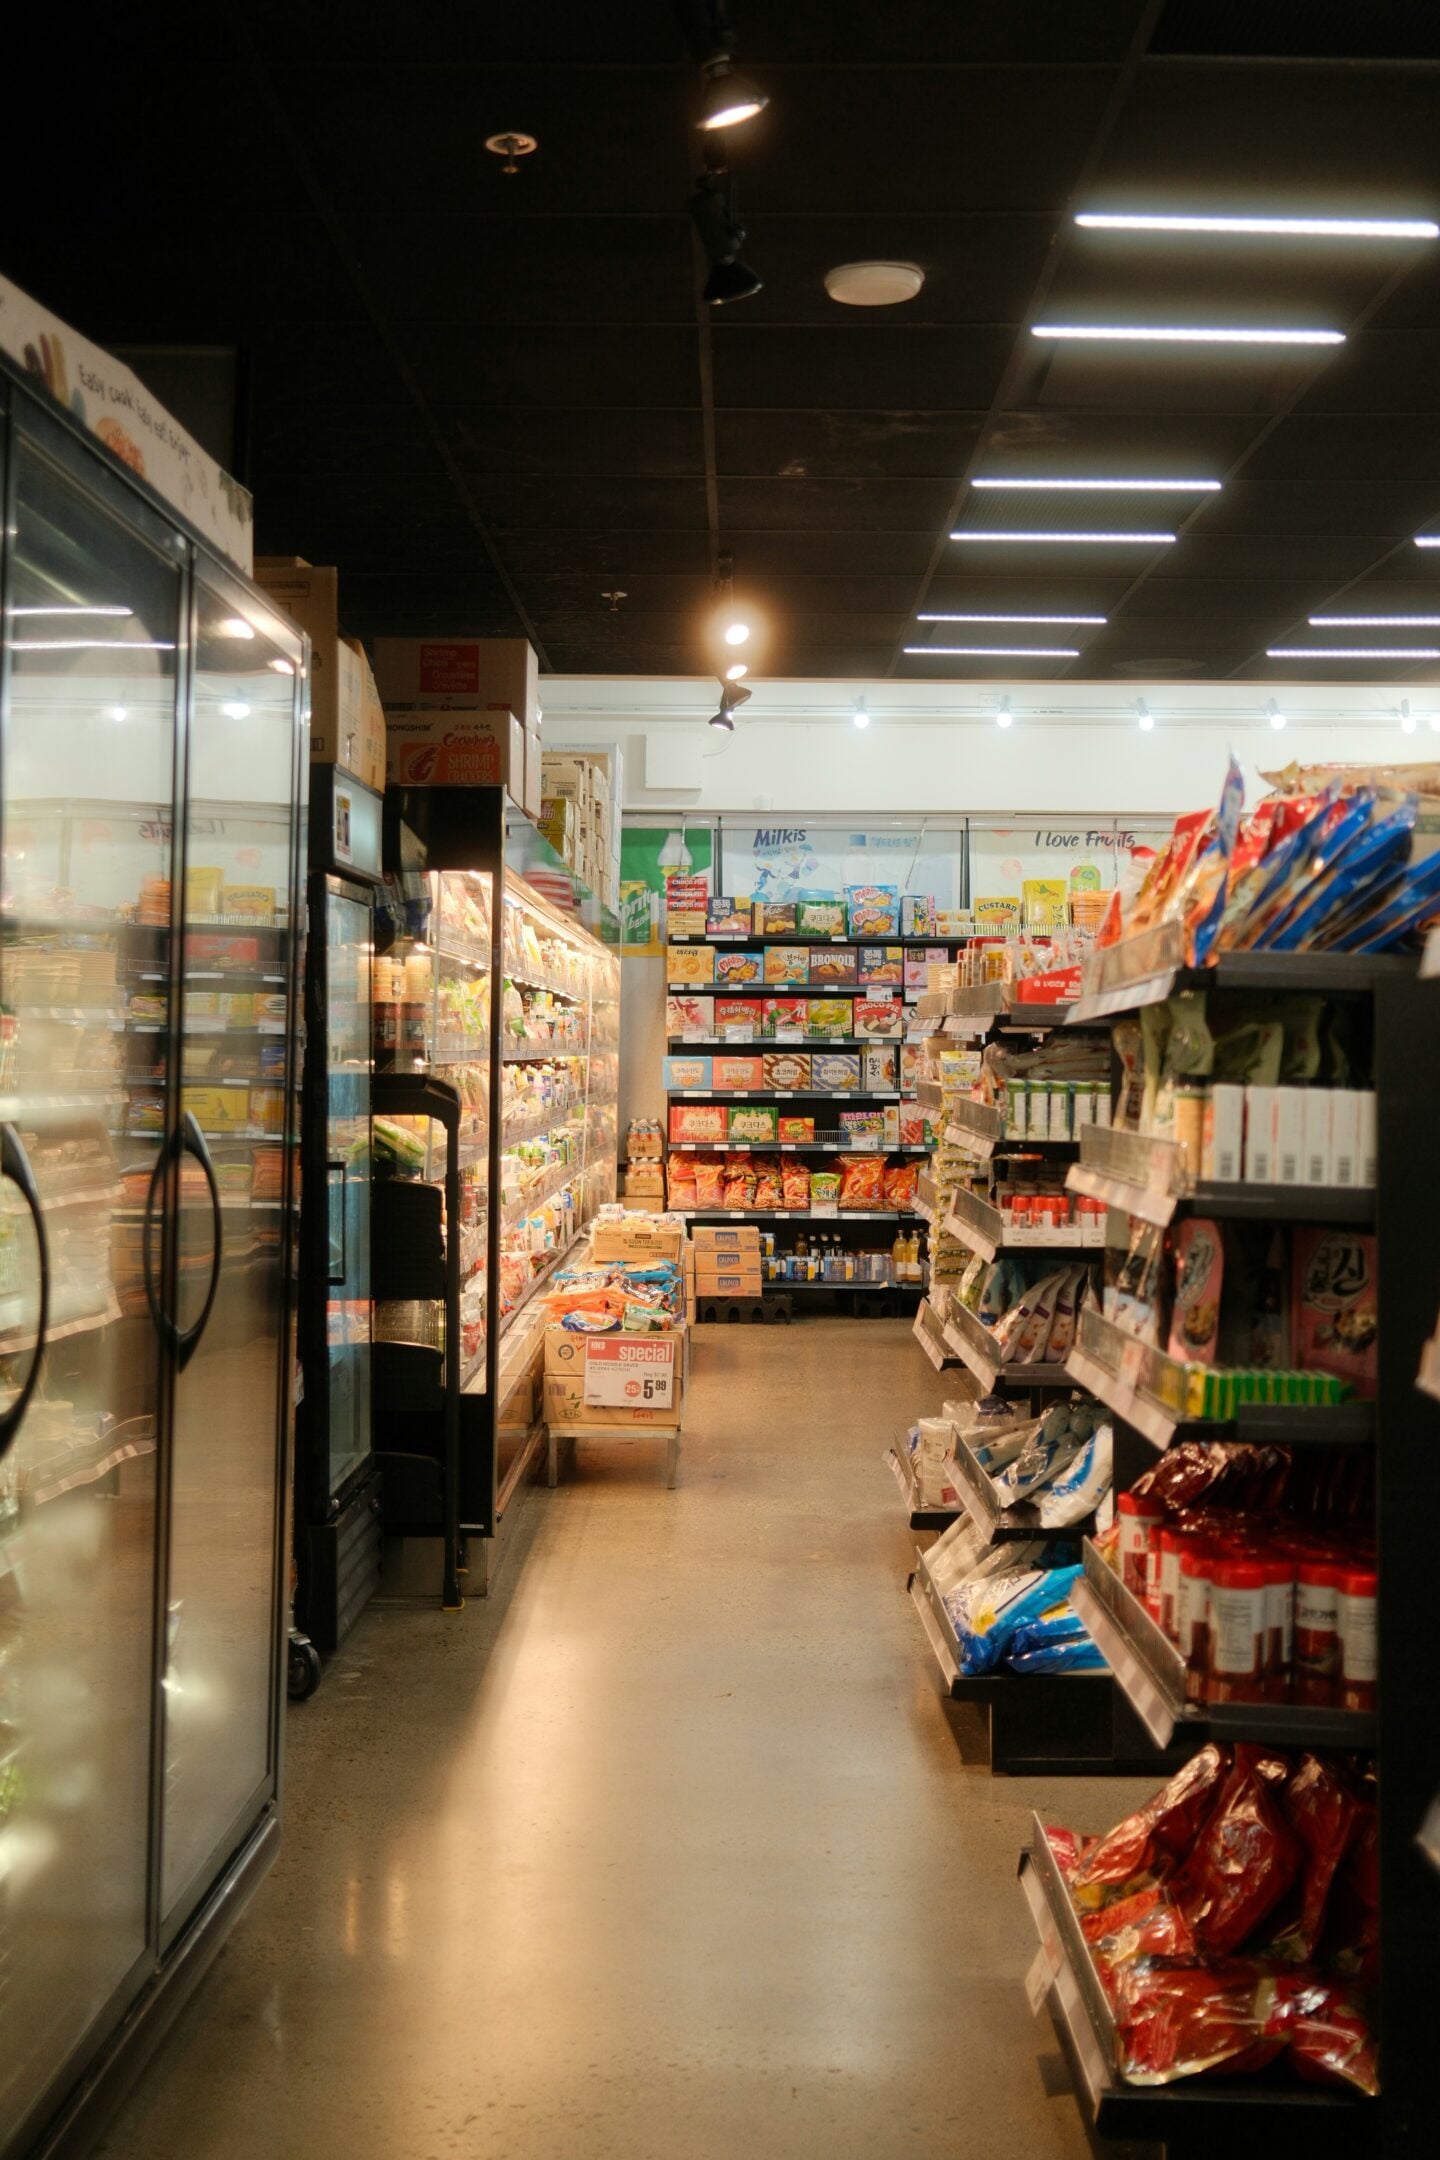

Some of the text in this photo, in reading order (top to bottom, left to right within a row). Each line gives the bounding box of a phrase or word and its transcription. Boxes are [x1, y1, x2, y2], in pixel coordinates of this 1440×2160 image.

[450, 754, 494, 769] SHRIMP
[753, 829, 807, 848] Milkis
[1035, 831, 1137, 849] I love Fruits
[978, 902, 1018, 912] CUSTARD
[810, 914, 836, 922] 쿠크다스
[811, 954, 856, 968] BRONOIR
[690, 1121, 715, 1129] 쿠크다스
[741, 1121, 767, 1129] 쿠크다스
[619, 1344, 670, 1362] special
